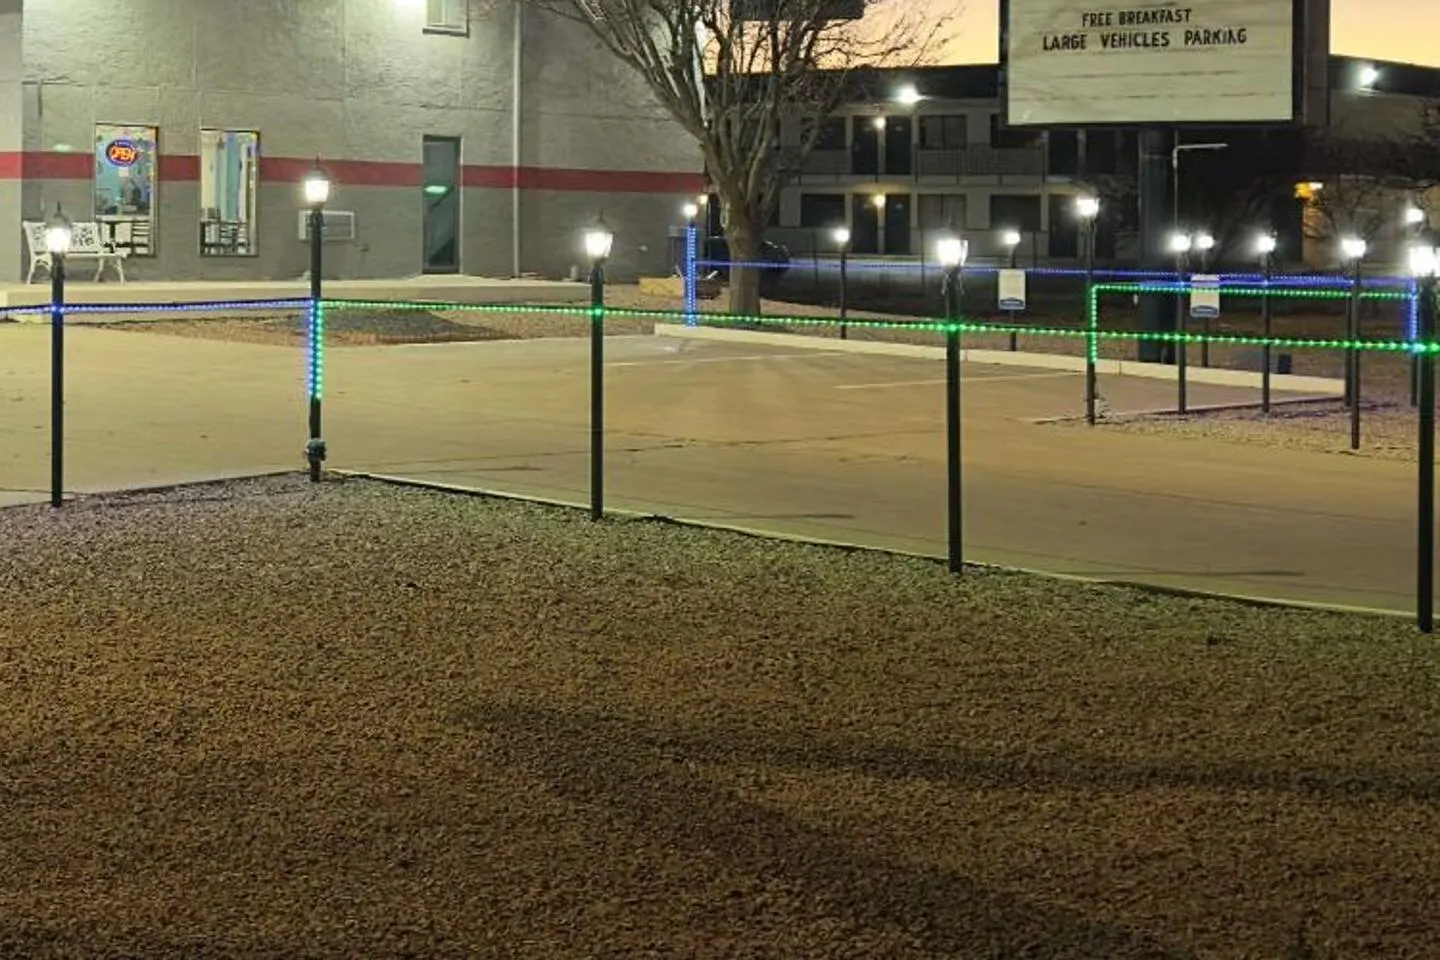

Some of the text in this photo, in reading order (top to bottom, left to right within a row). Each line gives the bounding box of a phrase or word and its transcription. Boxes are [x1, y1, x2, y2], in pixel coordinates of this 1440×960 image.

[1082, 8, 1192, 28] FREE BREAKFAST
[1043, 28, 1247, 51] LARGE VEHICLES PARKING
[110, 146, 137, 162] OPEN
